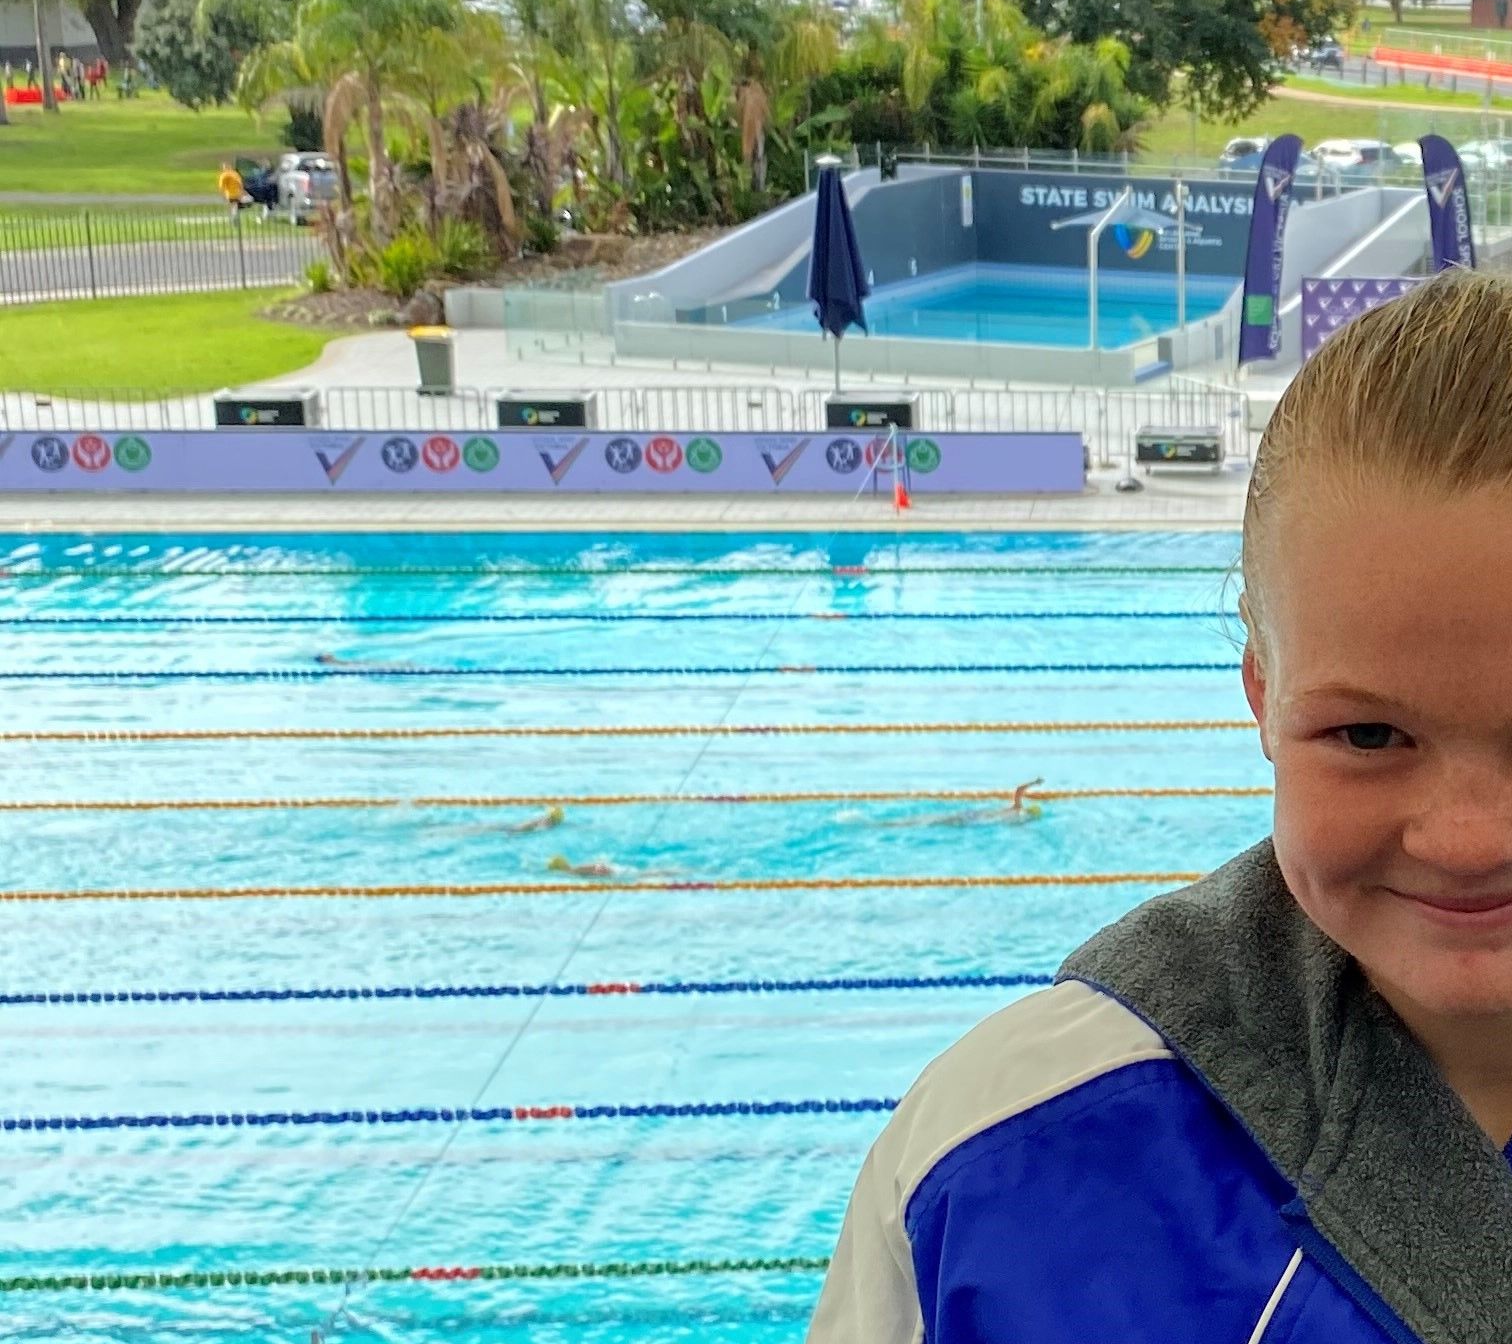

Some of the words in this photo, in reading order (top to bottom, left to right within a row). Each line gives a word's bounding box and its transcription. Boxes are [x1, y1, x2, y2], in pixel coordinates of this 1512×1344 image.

[1020, 185, 1087, 207] STATE
[1093, 189, 1155, 210] SWIM
[1161, 193, 1254, 216] ANALYSI
[1453, 186, 1469, 242] SCHOOL
